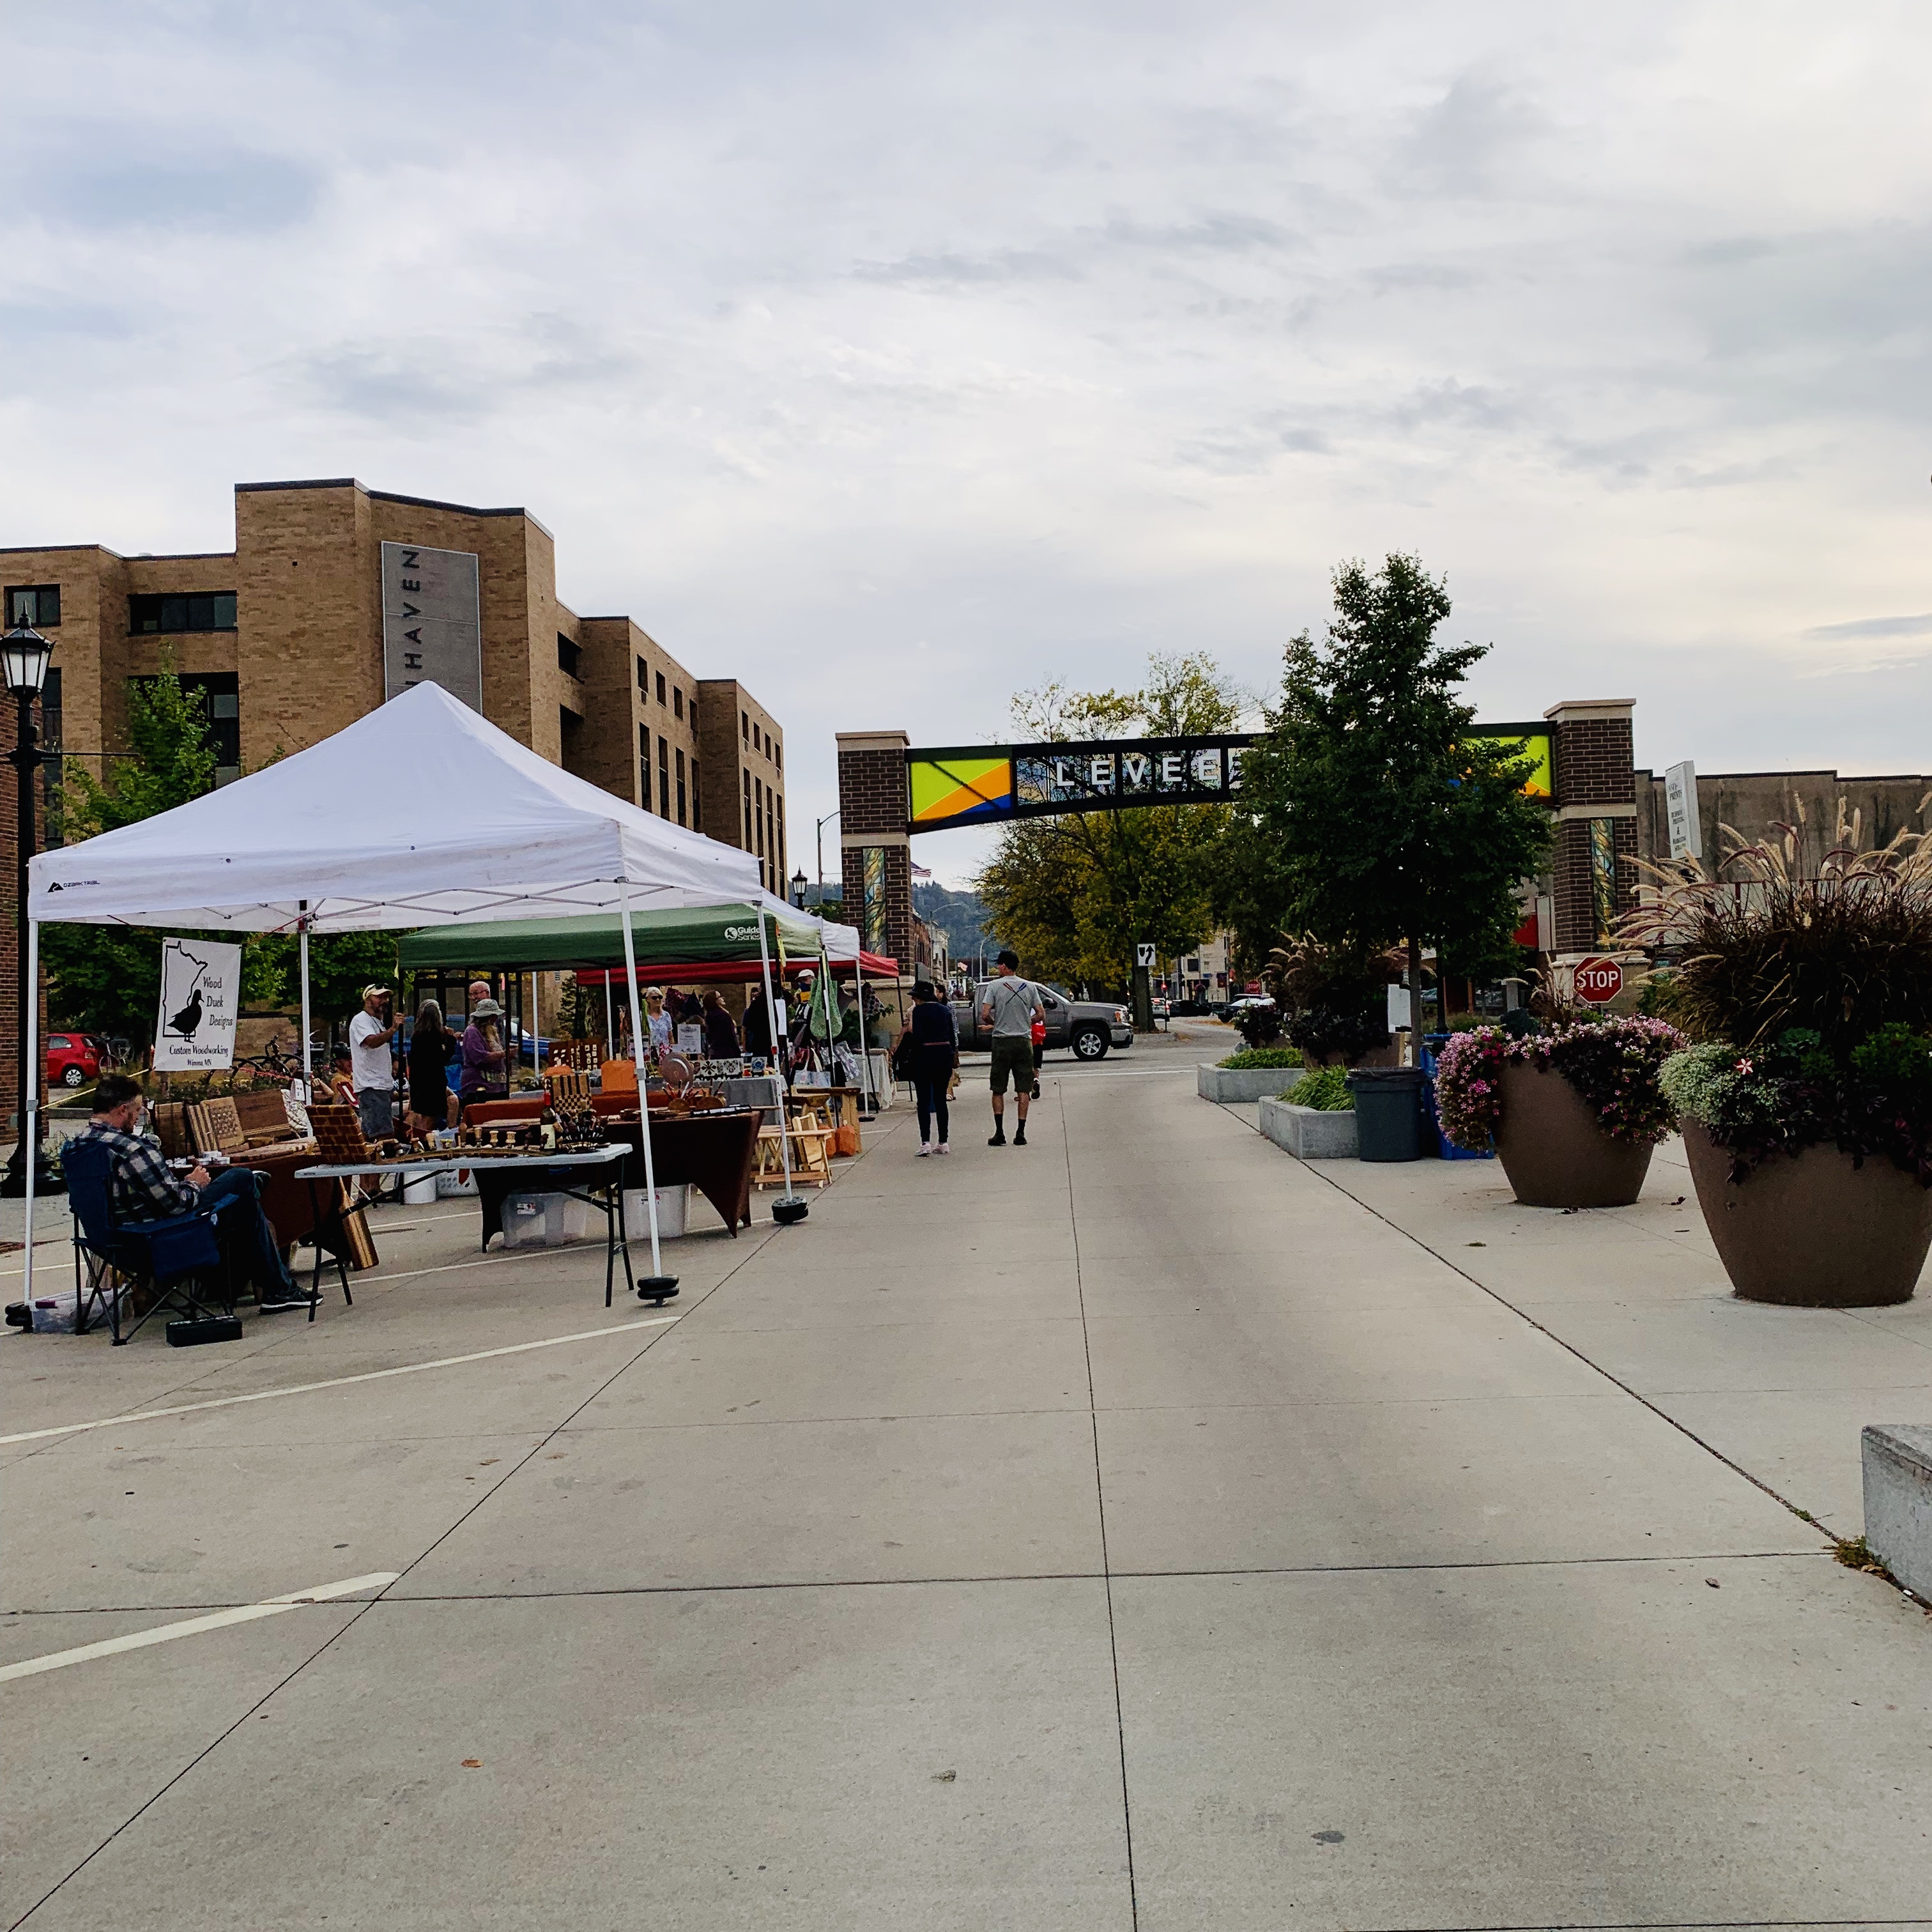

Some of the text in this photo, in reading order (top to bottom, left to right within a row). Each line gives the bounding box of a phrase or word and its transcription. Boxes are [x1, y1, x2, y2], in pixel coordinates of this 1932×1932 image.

[1056, 756, 1218, 786] LEVEE
[203, 976, 222, 988] Wood
[1577, 970, 1618, 988] STOP
[206, 995, 224, 1008] Duck
[209, 1014, 233, 1029] Designs
[169, 1044, 229, 1057] Custom Woodworking
